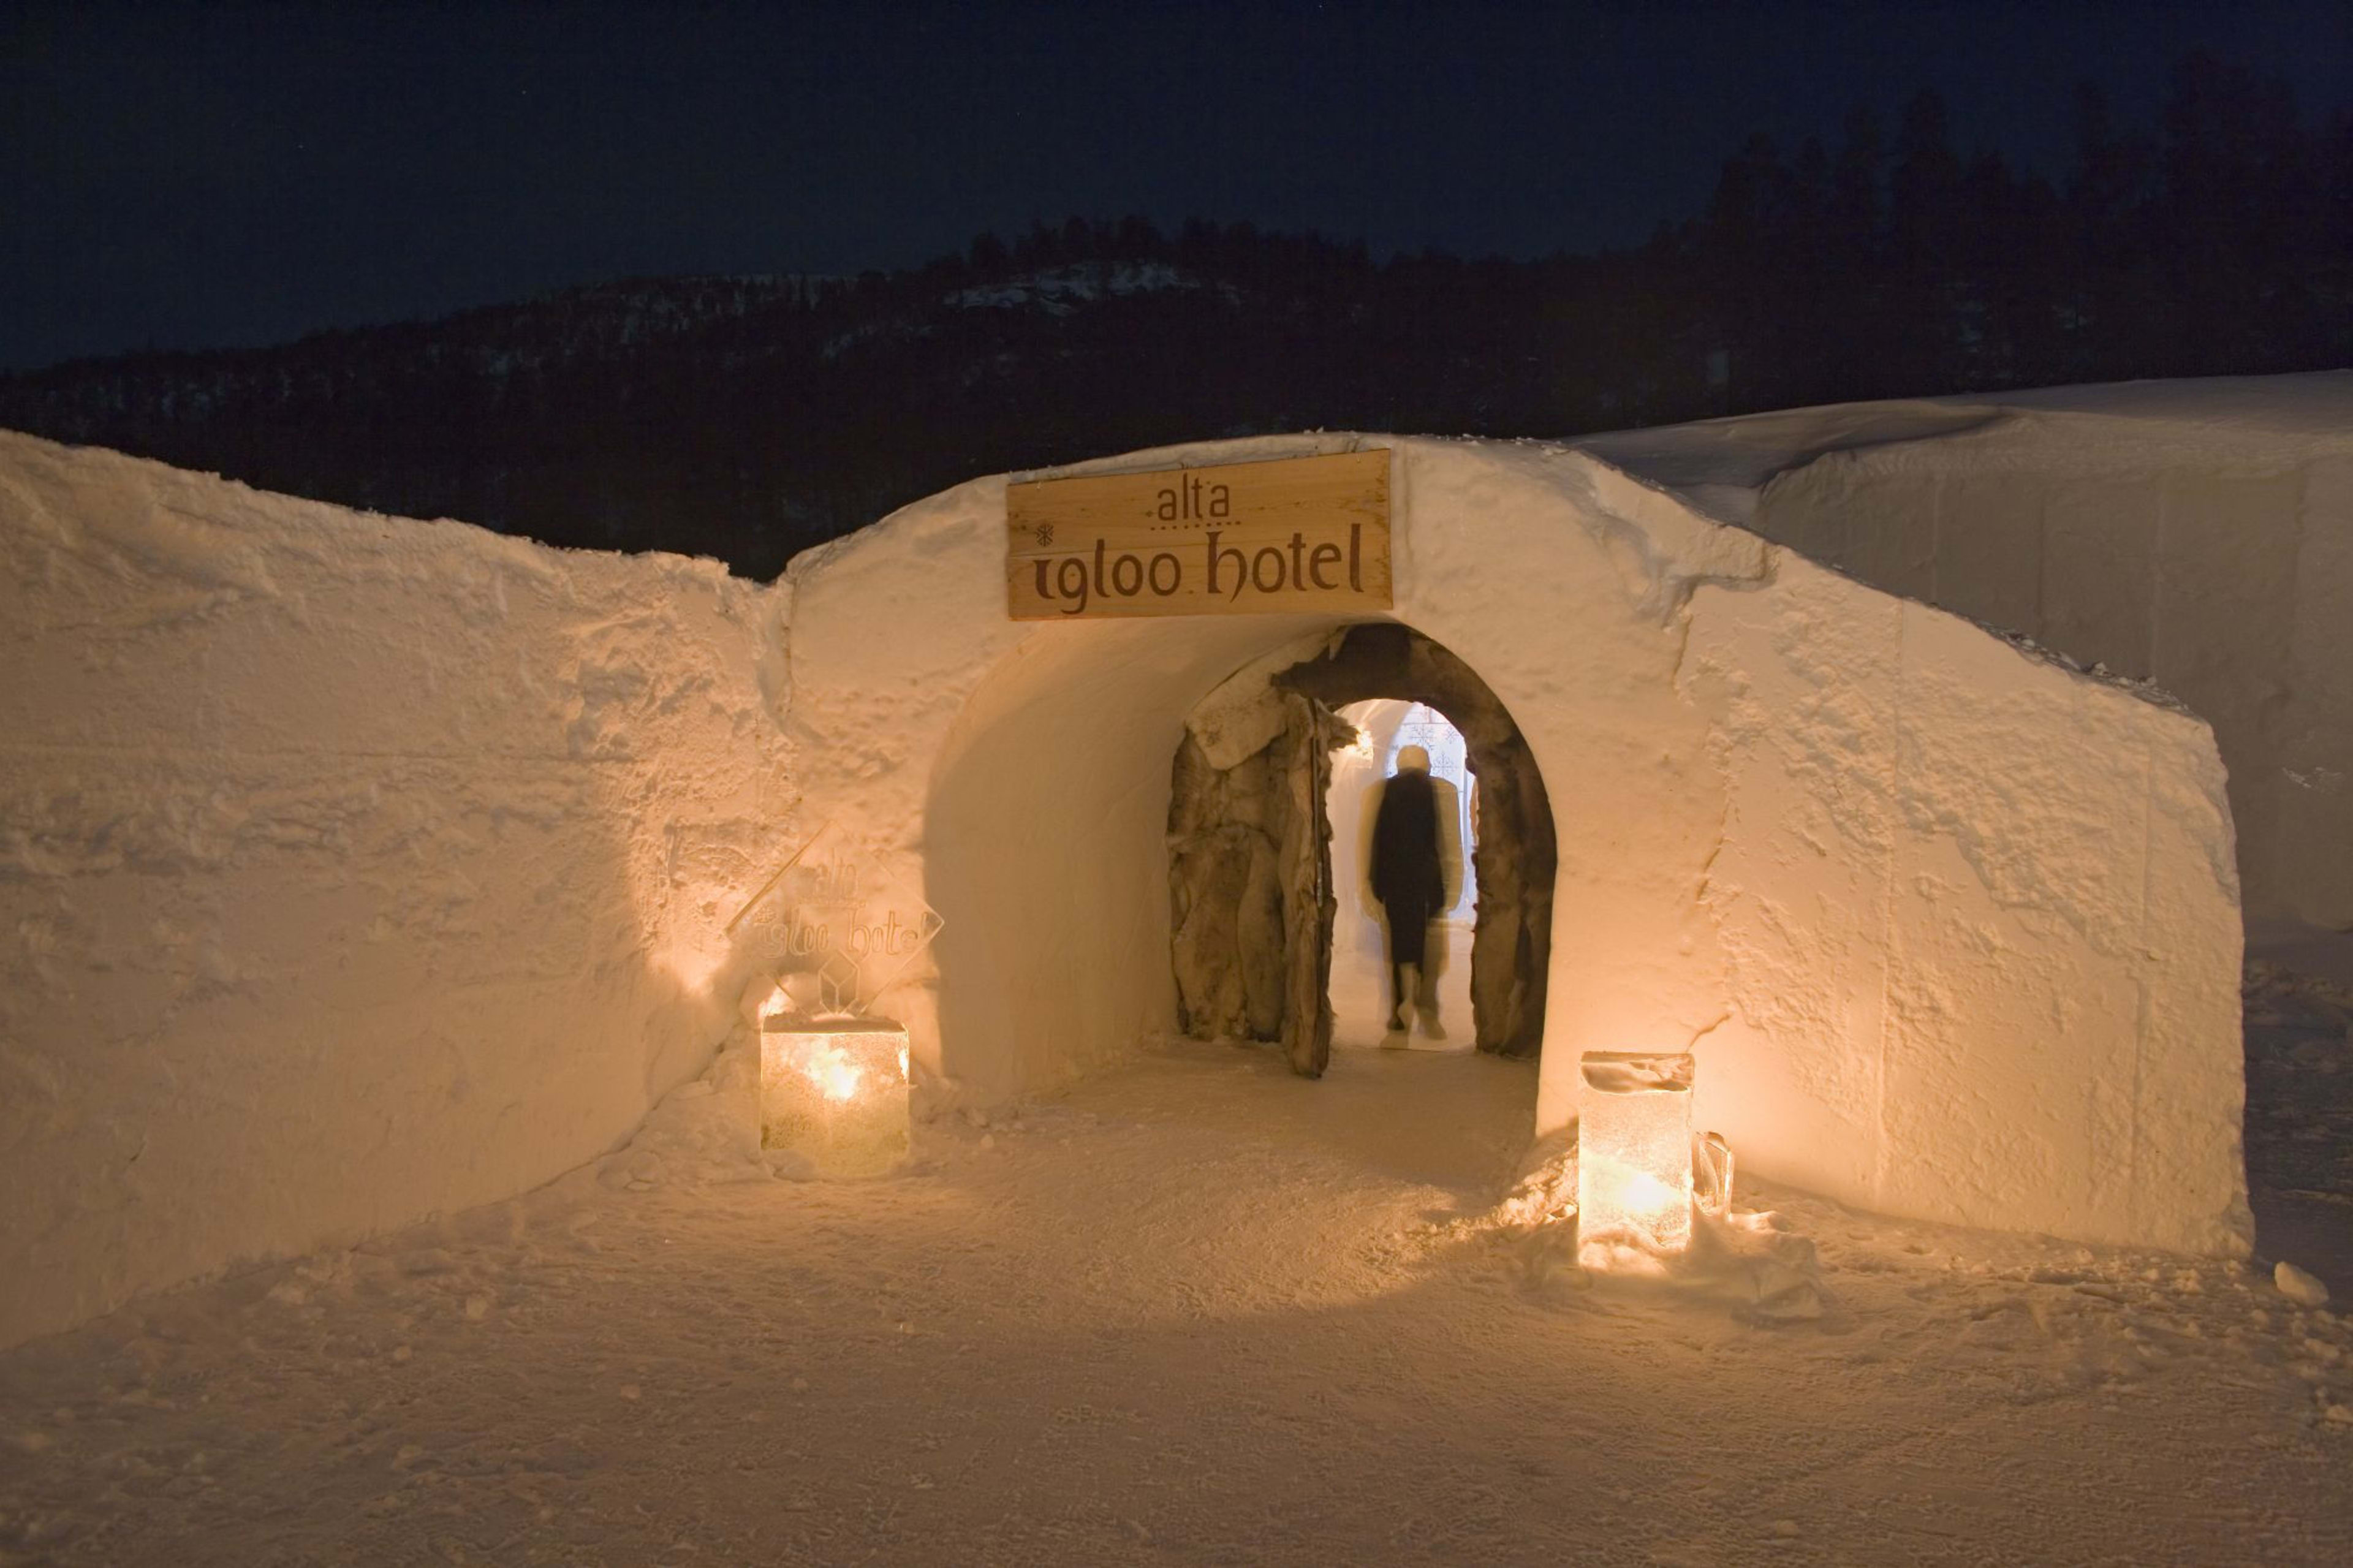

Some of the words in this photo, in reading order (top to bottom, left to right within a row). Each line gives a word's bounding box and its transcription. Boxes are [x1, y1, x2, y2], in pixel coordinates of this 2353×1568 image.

[1158, 472, 1229, 521] alta
[1033, 538, 1181, 614] igloo
[1205, 523, 1365, 602] hotel
[760, 906, 830, 959] igloo
[847, 908, 930, 961] hotel
